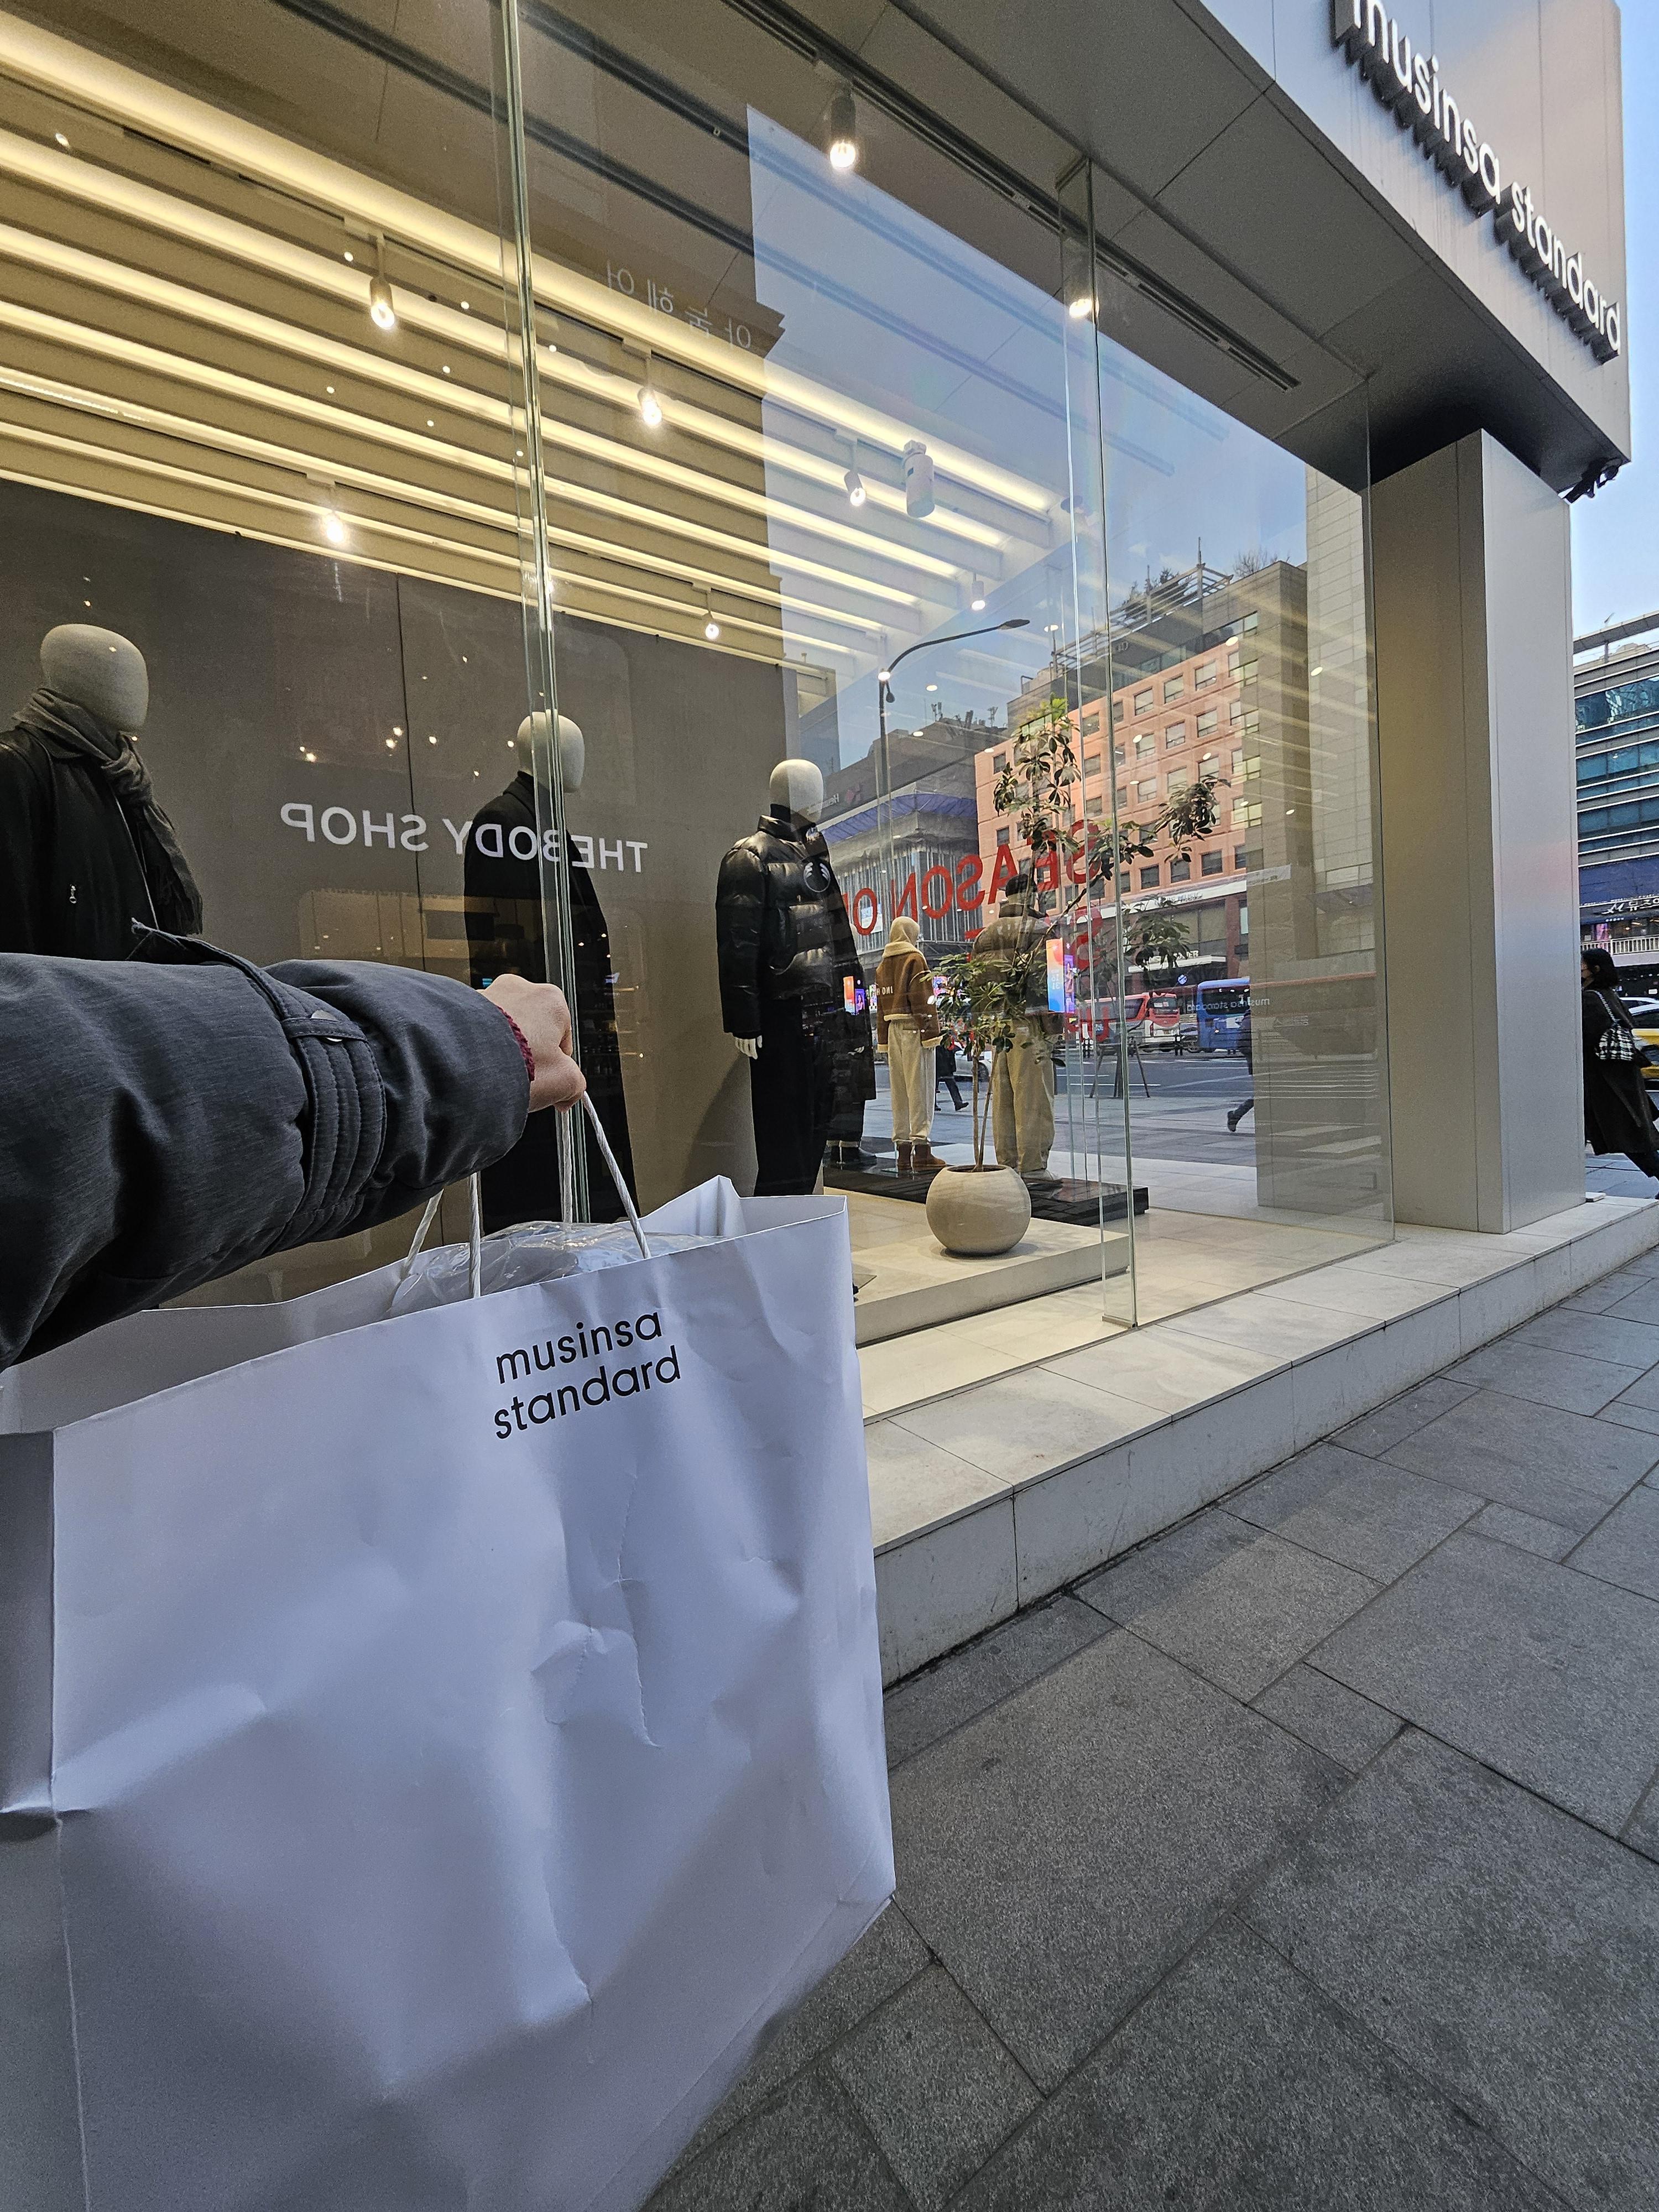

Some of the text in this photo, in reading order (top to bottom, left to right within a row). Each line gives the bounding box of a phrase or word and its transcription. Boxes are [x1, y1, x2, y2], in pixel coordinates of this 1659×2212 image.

[1353, 0, 1621, 354] musinsa standard
[494, 1345, 681, 1439] standard
[497, 1312, 662, 1384] musinsa
